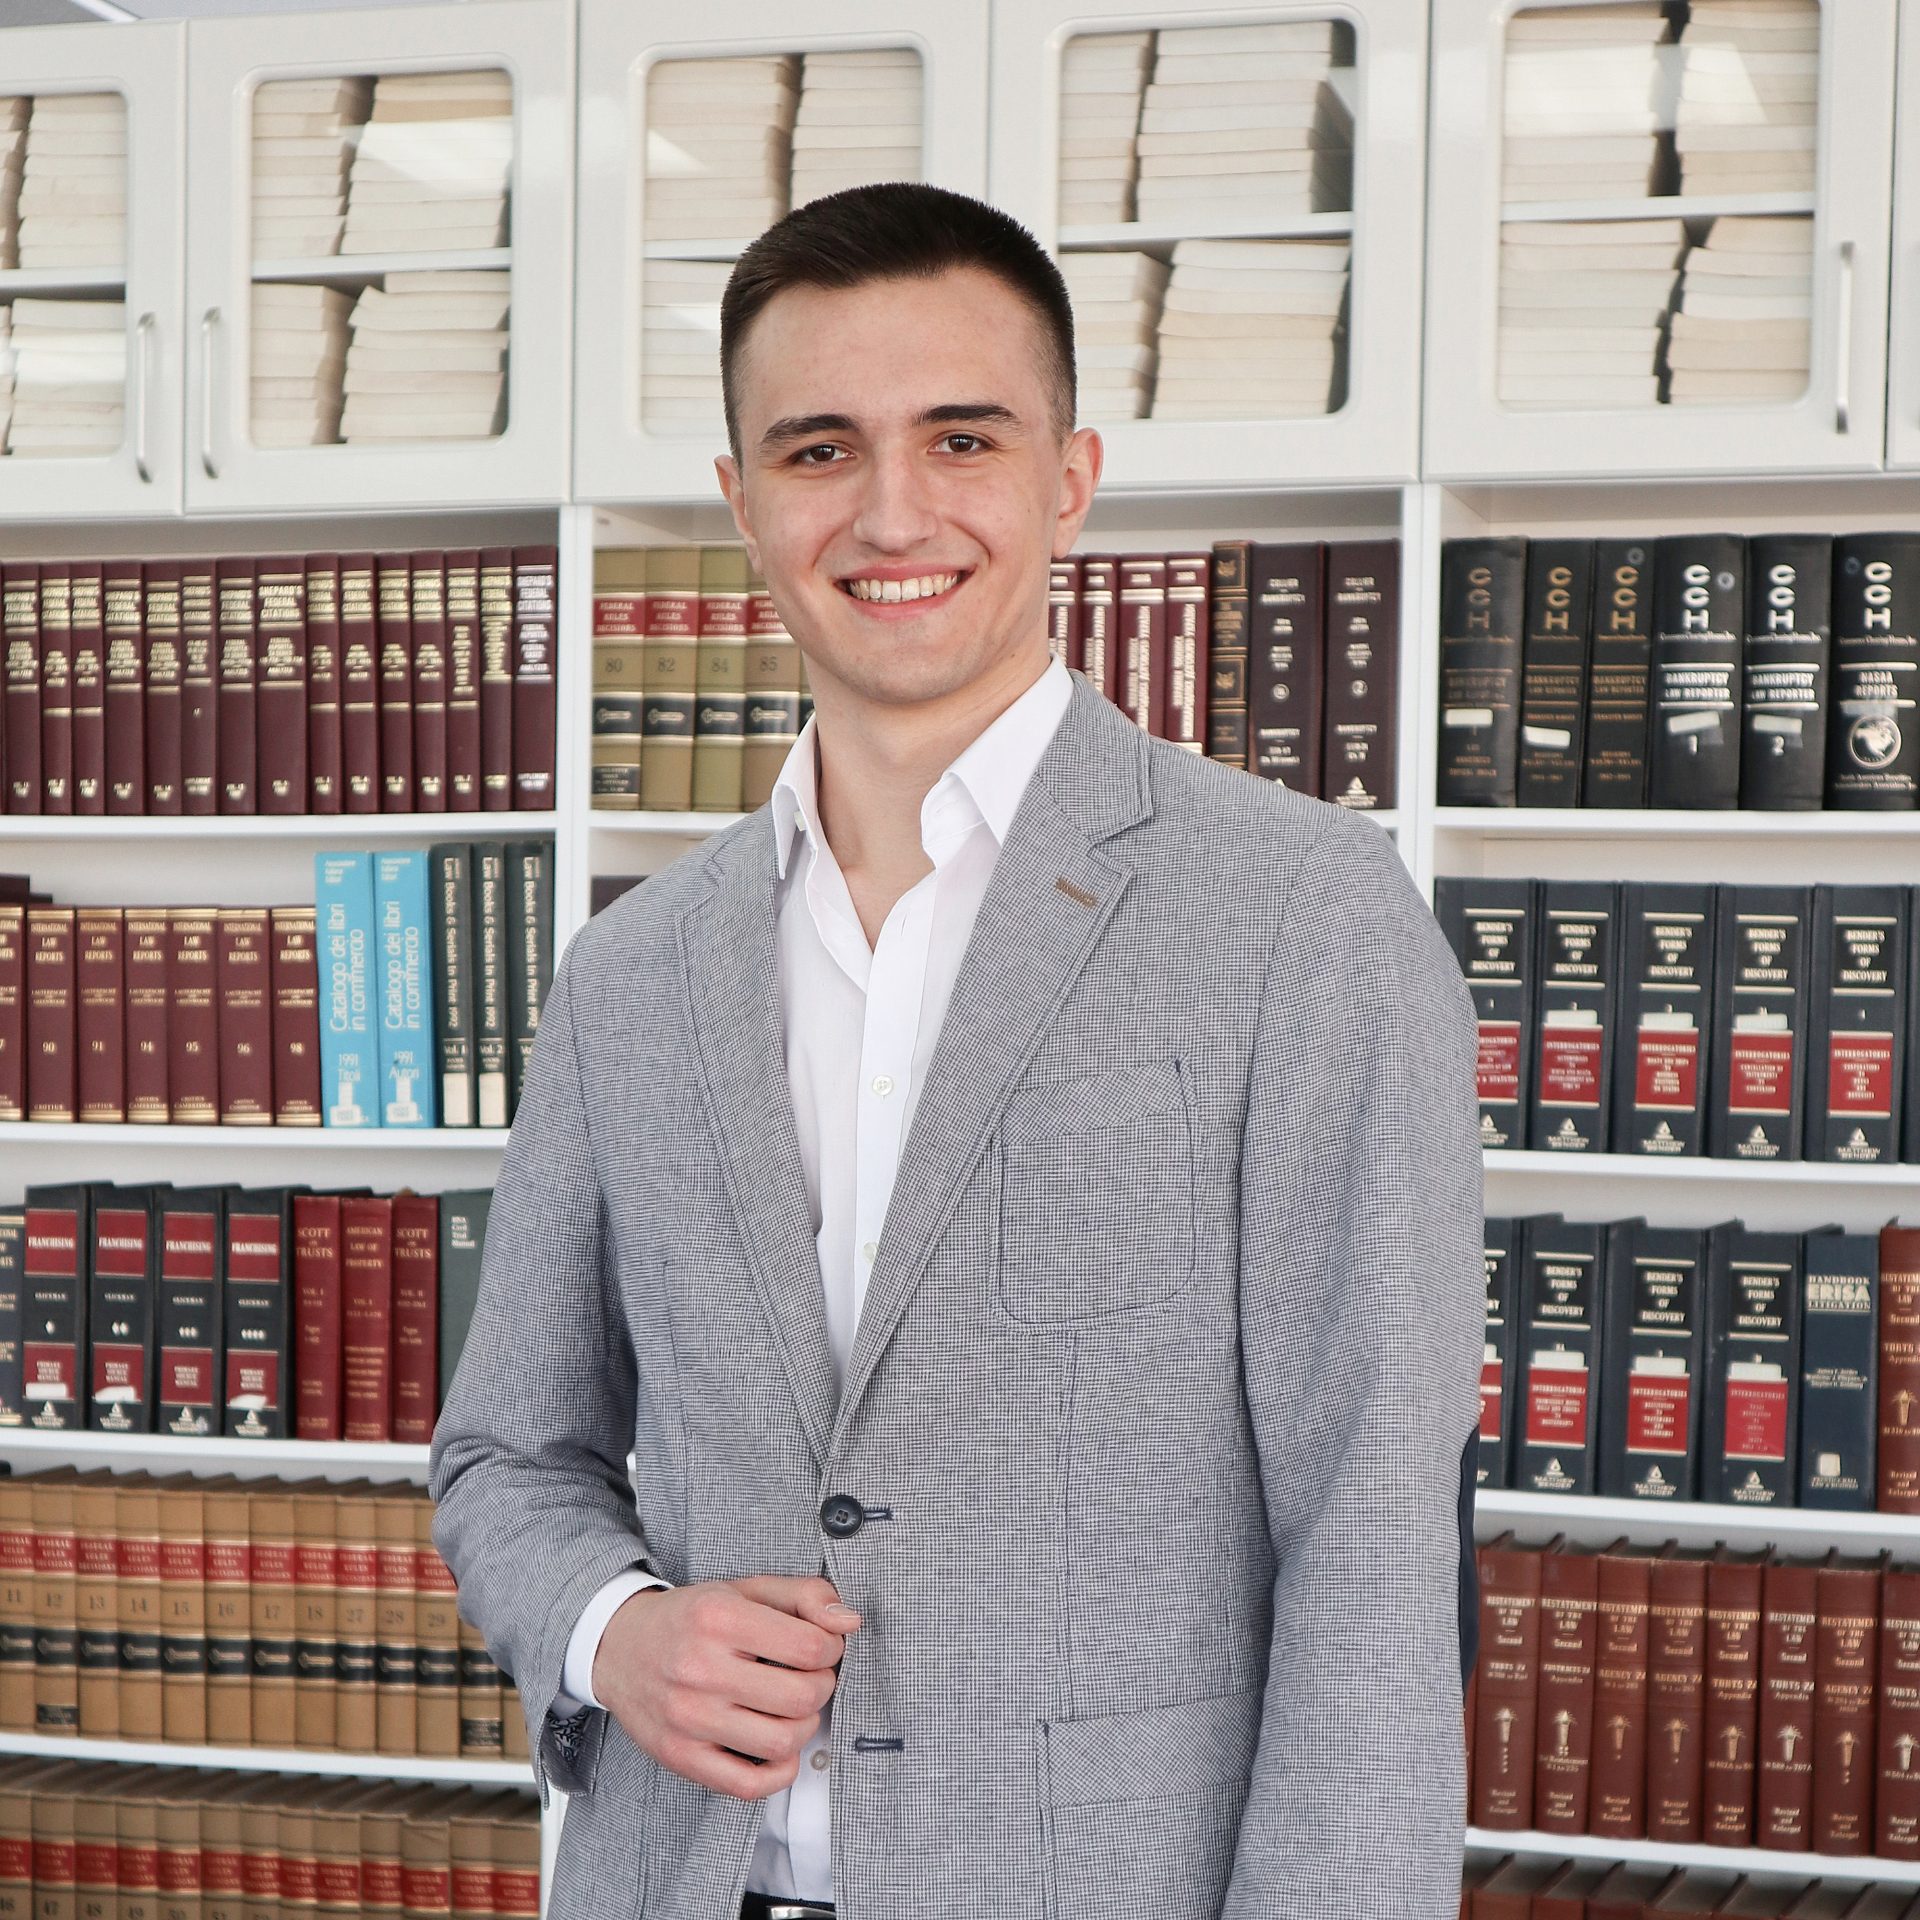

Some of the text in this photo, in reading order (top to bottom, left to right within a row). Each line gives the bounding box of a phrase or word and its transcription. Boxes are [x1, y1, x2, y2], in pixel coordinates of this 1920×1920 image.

[259, 586, 303, 598] SHEPARD'S
[519, 588, 549, 599] FEDERAL
[1611, 565, 1639, 630] CCH
[1683, 564, 1711, 630] CCH
[1768, 564, 1796, 630] CCH
[1864, 561, 1893, 630] CCH
[264, 597, 297, 608] FEDERAL
[1468, 567, 1492, 629] CCH
[1544, 566, 1573, 630] CCH
[517, 599, 552, 612] CITATIONS
[260, 608, 300, 620] CITATIONS
[605, 658, 623, 673] 80
[658, 658, 676, 672] 82
[1665, 671, 1729, 685] BANKRUPTCY
[1752, 672, 1814, 686] BANKRUPTCY
[1665, 688, 1731, 698] LAW REPORTER
[1752, 688, 1815, 699] LAW REPORTER
[1855, 684, 1898, 698] REPORTS
[1772, 735, 1784, 755] 2
[443, 857, 454, 878] Law
[482, 857, 492, 878] Law
[524, 857, 533, 878] Law
[444, 882, 455, 915] Books
[483, 881, 494, 915] Books
[524, 881, 534, 914] Books
[31, 923, 67, 933] INTERNATIONAL
[128, 922, 165, 931] INTERNATIONAL
[174, 922, 210, 931] INTERNATIONAL
[224, 923, 262, 932] INTERNATIONAL
[275, 921, 314, 930] INTERNATIONAL
[1474, 922, 1513, 934] BENDER'S
[1559, 925, 1596, 936] BENDER'S
[1747, 928, 1787, 940] BENDER'S
[1845, 930, 1885, 942] BENDER'S
[42, 938, 57, 947] LAW
[139, 936, 154, 945] LAW
[184, 936, 200, 946] LAW
[235, 938, 251, 946] LAW
[287, 935, 302, 945] LAW
[1481, 936, 1508, 945] FORMS
[1564, 938, 1592, 947] FORMS
[443, 927, 456, 967] Serials
[483, 927, 495, 966] Serials
[524, 927, 535, 967] Serials
[1752, 943, 1781, 953] FORMS
[1852, 945, 1880, 955] FORMS
[36, 952, 64, 961] REPORTS
[133, 950, 161, 960] REPORTS
[178, 950, 207, 960] REPORTS
[229, 952, 258, 961] REPORTS
[280, 949, 310, 960] REPORTS
[1488, 948, 1500, 958] OF
[1571, 951, 1583, 961] OF
[383, 901, 402, 1029] Catalogo dei libri
[1760, 956, 1773, 966] OF
[1859, 957, 1871, 967] OF
[327, 904, 348, 1033] Catalogo dei libri
[1471, 962, 1515, 972] DISCOVERY
[1554, 964, 1598, 974] DISCOVERY
[403, 927, 420, 1029] in commercio
[1743, 968, 1788, 979] DISCOVERY
[1843, 970, 1887, 981] DISCOVERY
[348, 929, 365, 1032] in commercio
[447, 979, 457, 1003] Print
[485, 979, 495, 1003] Print
[527, 979, 536, 1003] Print
[448, 1006, 458, 1028] 1992
[485, 1006, 495, 1028] 1992
[527, 1006, 538, 1028] 1992
[43, 1042, 55, 1053] 90
[92, 1041, 103, 1052] 91
[186, 1041, 198, 1052] 95
[237, 1043, 250, 1053] 96
[290, 1043, 303, 1053] 98
[496, 1045, 504, 1054] 2
[394, 1051, 413, 1065] 1991
[1835, 1050, 1890, 1058] INTERROGATORIES
[339, 1053, 358, 1067] 1991
[389, 1066, 420, 1080] Autori
[298, 1228, 331, 1238] SCOTT
[397, 1229, 428, 1239] SCOTT
[29, 1237, 73, 1248] FRANCHISING
[99, 1238, 142, 1249] FRANCHISING
[166, 1240, 211, 1251] FRANCHISING
[232, 1242, 277, 1254] FRANCHISING
[297, 1247, 333, 1257] TRUSTS
[395, 1248, 431, 1258] TRUSTS
[1544, 1266, 1583, 1277] BENDER'S
[1646, 1272, 1684, 1282] BENDER'S
[1551, 1279, 1577, 1289] FORMS
[1741, 1276, 1779, 1287] BENDER'S
[1809, 1276, 1870, 1285] HANDBOOK
[1651, 1285, 1678, 1295] FORMS
[1748, 1289, 1774, 1300] FORMS
[1808, 1284, 1870, 1301] ERISA
[1558, 1292, 1568, 1302] OF
[1659, 1298, 1670, 1308] OF
[1755, 1303, 1766, 1313] OF
[1809, 1301, 1870, 1309] LITIGATION
[1540, 1305, 1584, 1316] DISCOVERY
[1641, 1311, 1685, 1322] DISCOVERY
[1738, 1315, 1782, 1327] DISCOVERY
[1486, 1597, 1536, 1607] RESTATEMENT
[1542, 1598, 1597, 1610] RESTATEMENT
[1709, 1611, 1760, 1620] RESTATEMENT
[1822, 1618, 1878, 1627] RESTATEMENT
